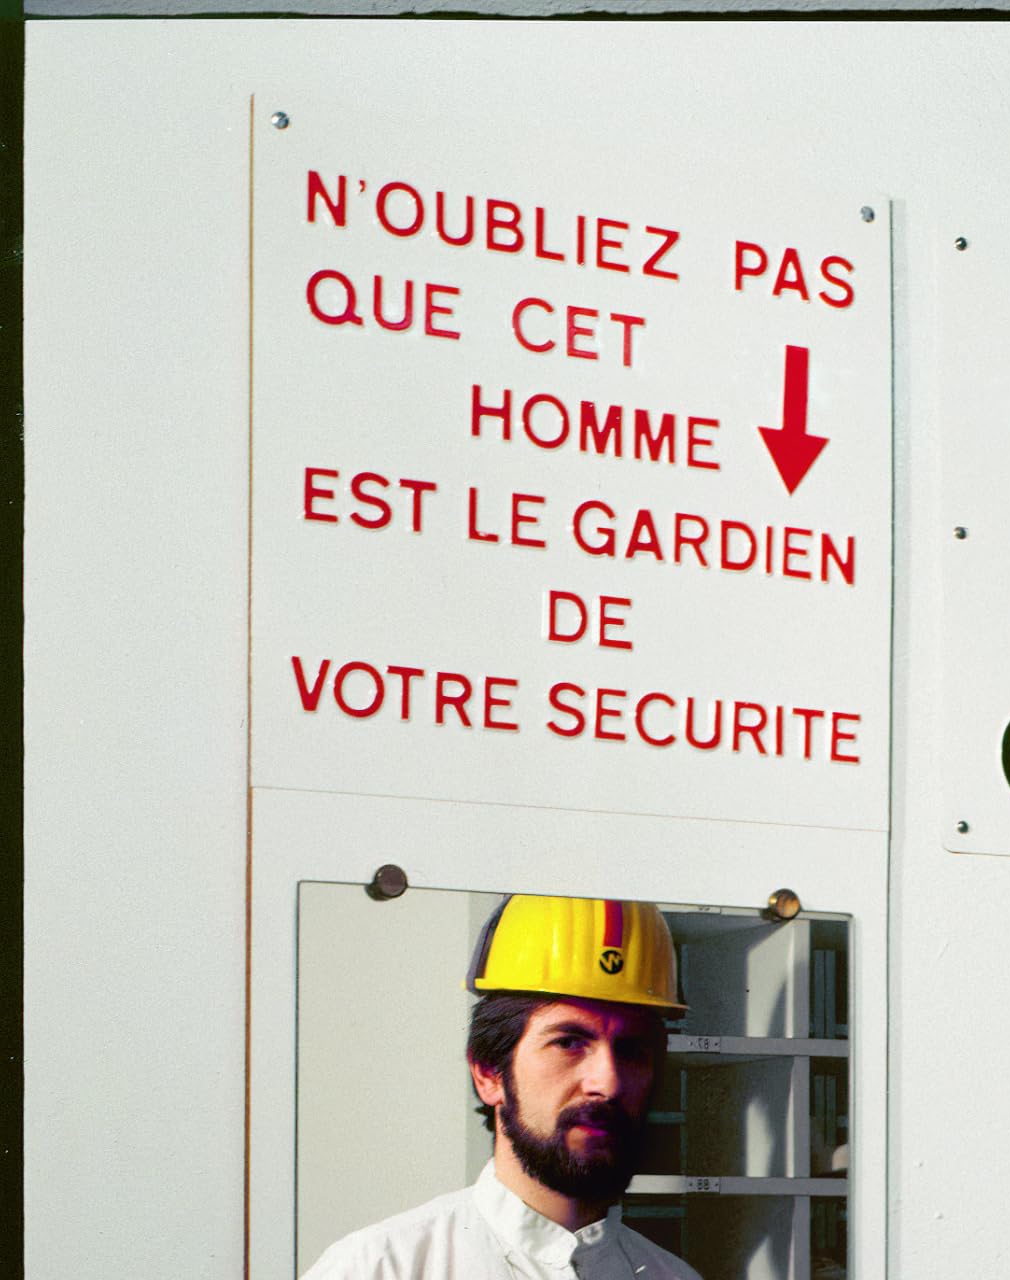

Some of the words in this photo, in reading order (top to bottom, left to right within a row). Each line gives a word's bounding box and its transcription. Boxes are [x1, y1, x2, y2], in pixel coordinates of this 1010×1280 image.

[308, 171, 679, 280] N'OUBLIEZ
[735, 240, 854, 308] PAS
[306, 270, 460, 340] QUE
[512, 297, 645, 367] CET
[471, 384, 720, 470] HOMME
[304, 468, 437, 532] EST
[468, 487, 545, 548] LE
[573, 500, 854, 585] GARDIEN
[548, 590, 632, 650] DE
[292, 656, 518, 730] VOTRE
[547, 682, 860, 763] SECURITE
